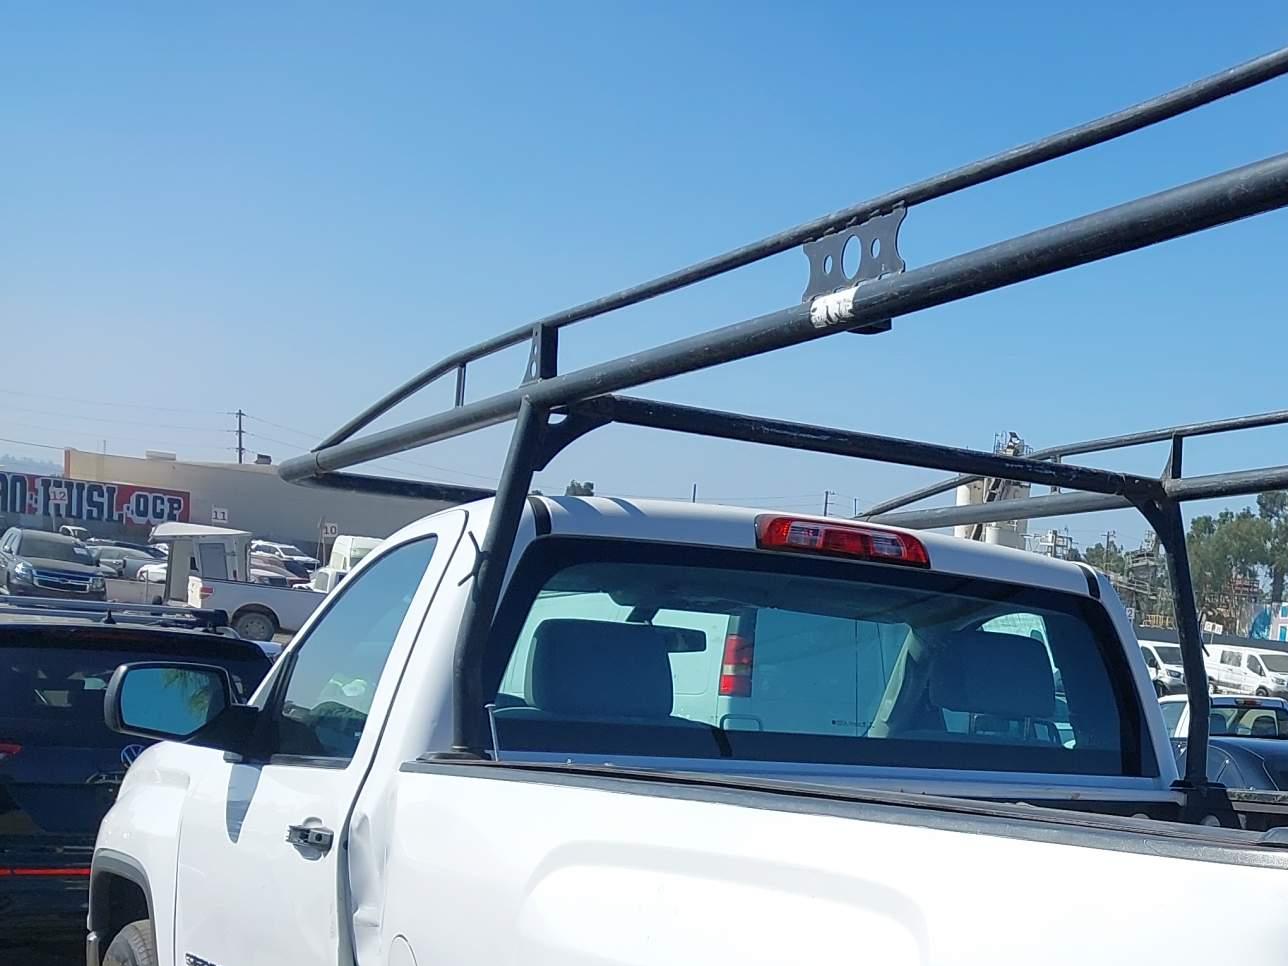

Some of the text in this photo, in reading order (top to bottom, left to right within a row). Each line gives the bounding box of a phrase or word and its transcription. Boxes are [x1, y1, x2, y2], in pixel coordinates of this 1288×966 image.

[51, 490, 66, 501] 12
[213, 510, 226, 520] 11
[324, 525, 337, 535] 10
